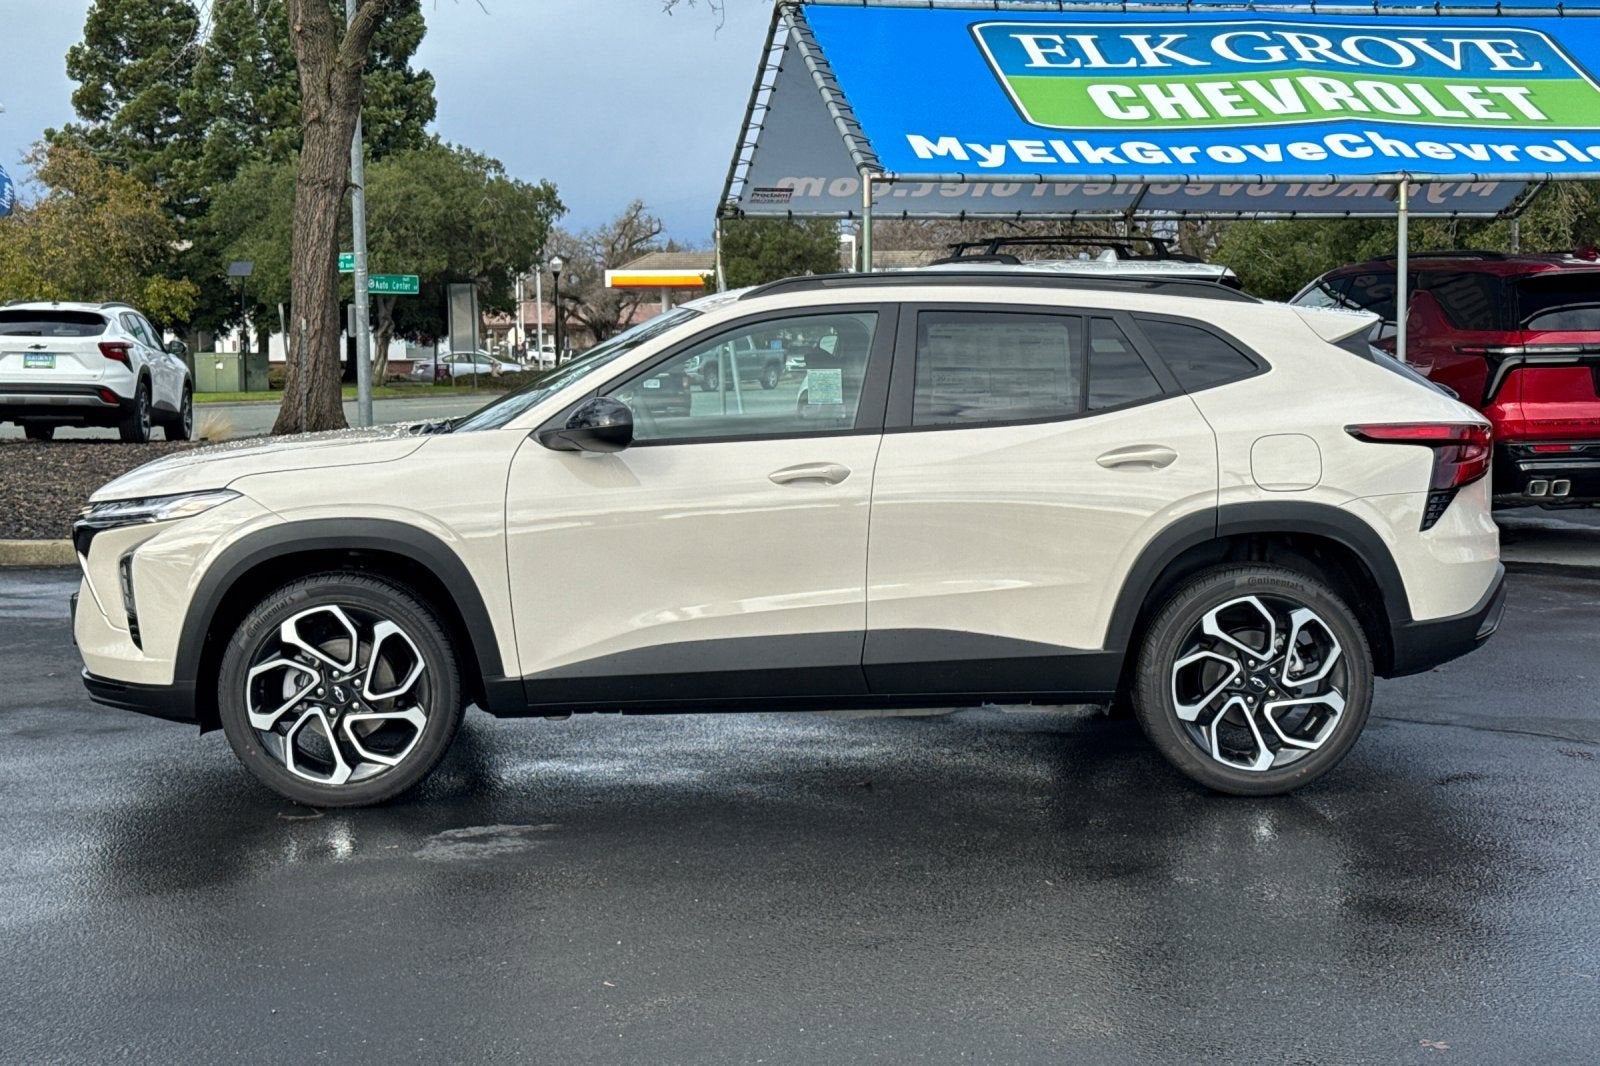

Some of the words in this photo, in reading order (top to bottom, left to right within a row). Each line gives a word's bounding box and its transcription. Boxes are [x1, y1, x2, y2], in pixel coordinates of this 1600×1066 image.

[1009, 33, 1212, 68] ELK
[1210, 30, 1543, 71] GROVE
[1087, 75, 1549, 120] CHEVROLET
[375, 280, 389, 291] Auto
[392, 280, 411, 291] Center
[1248, 576, 1301, 589] Continental
[247, 599, 289, 638] Continental
